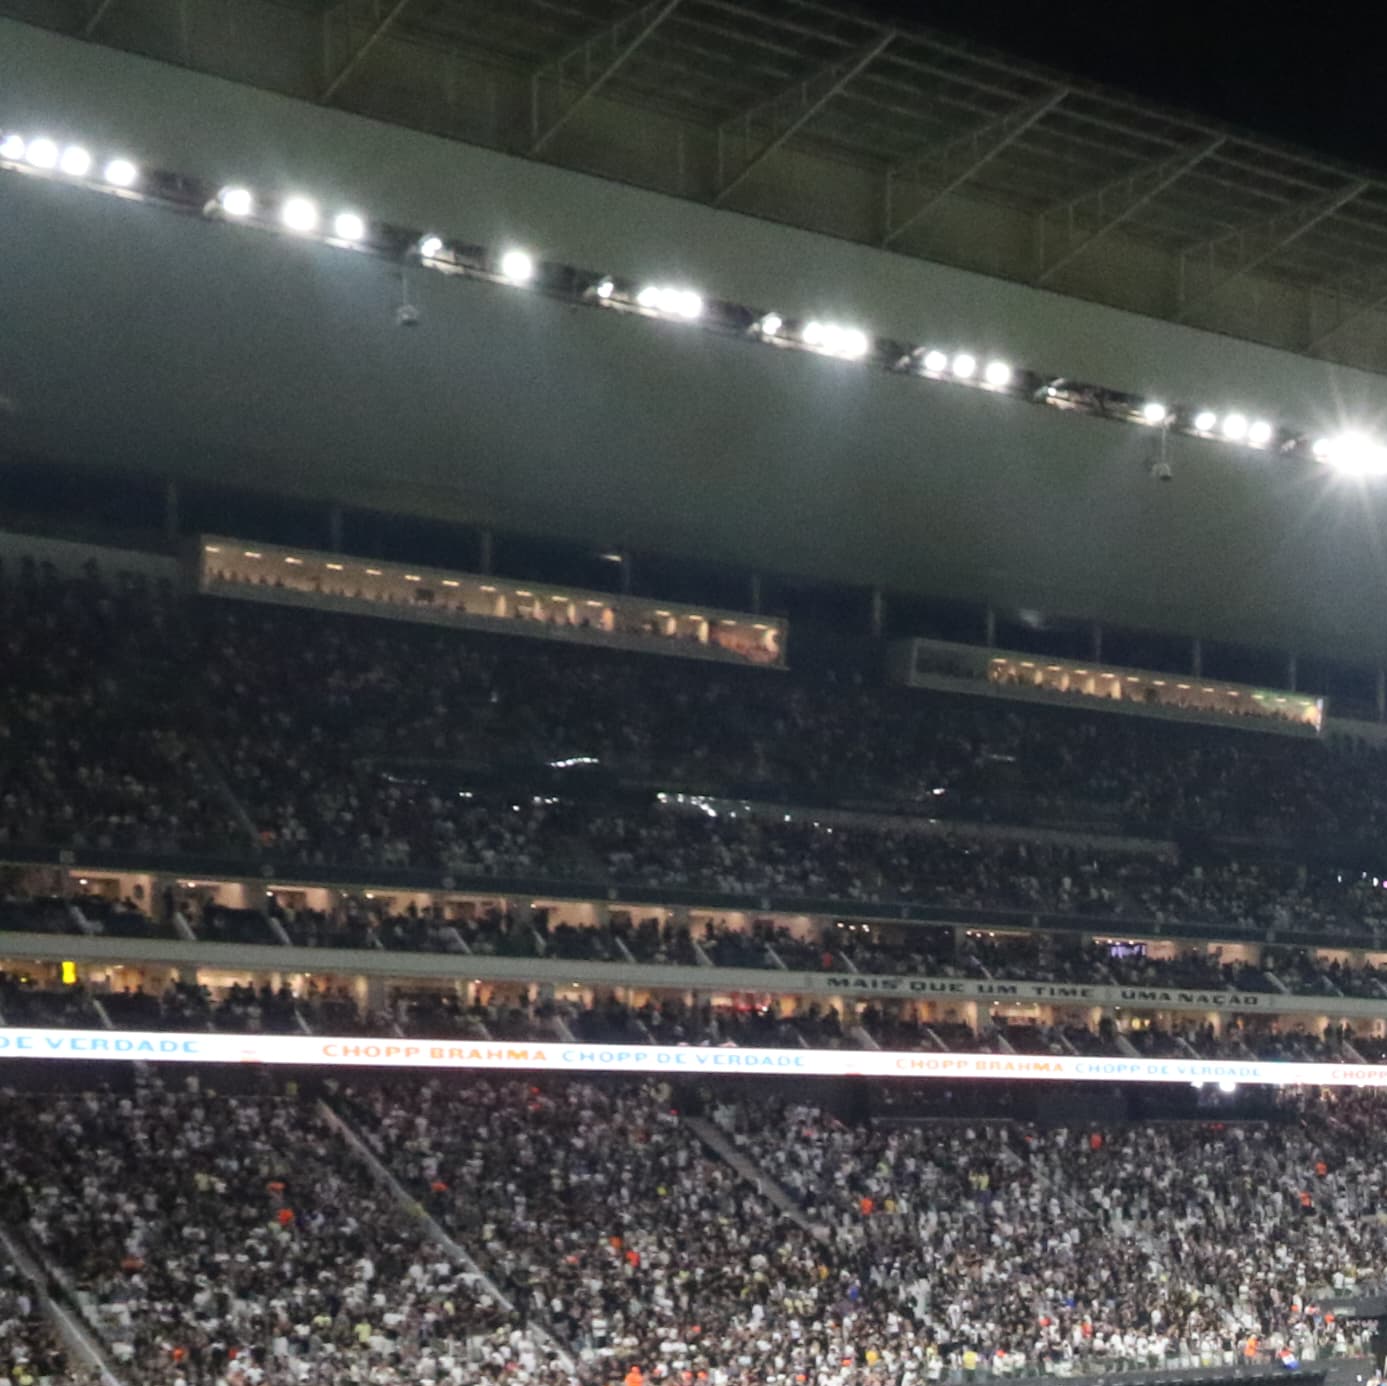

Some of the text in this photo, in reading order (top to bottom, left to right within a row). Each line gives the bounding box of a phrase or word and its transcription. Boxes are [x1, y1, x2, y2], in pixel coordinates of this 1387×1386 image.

[827, 977, 1095, 998] MAIS QUE UM TIME
[1120, 988, 1170, 1001] UMA
[44, 1036, 200, 1053] VERDADE
[322, 1043, 547, 1061] CHOPP BRAHMA
[562, 1050, 806, 1067] CHOPP DE VERDADE
[896, 1058, 1064, 1072] CHOPP BRAHMA
[1075, 1062, 1261, 1079] CHOPP DE VERDADE
